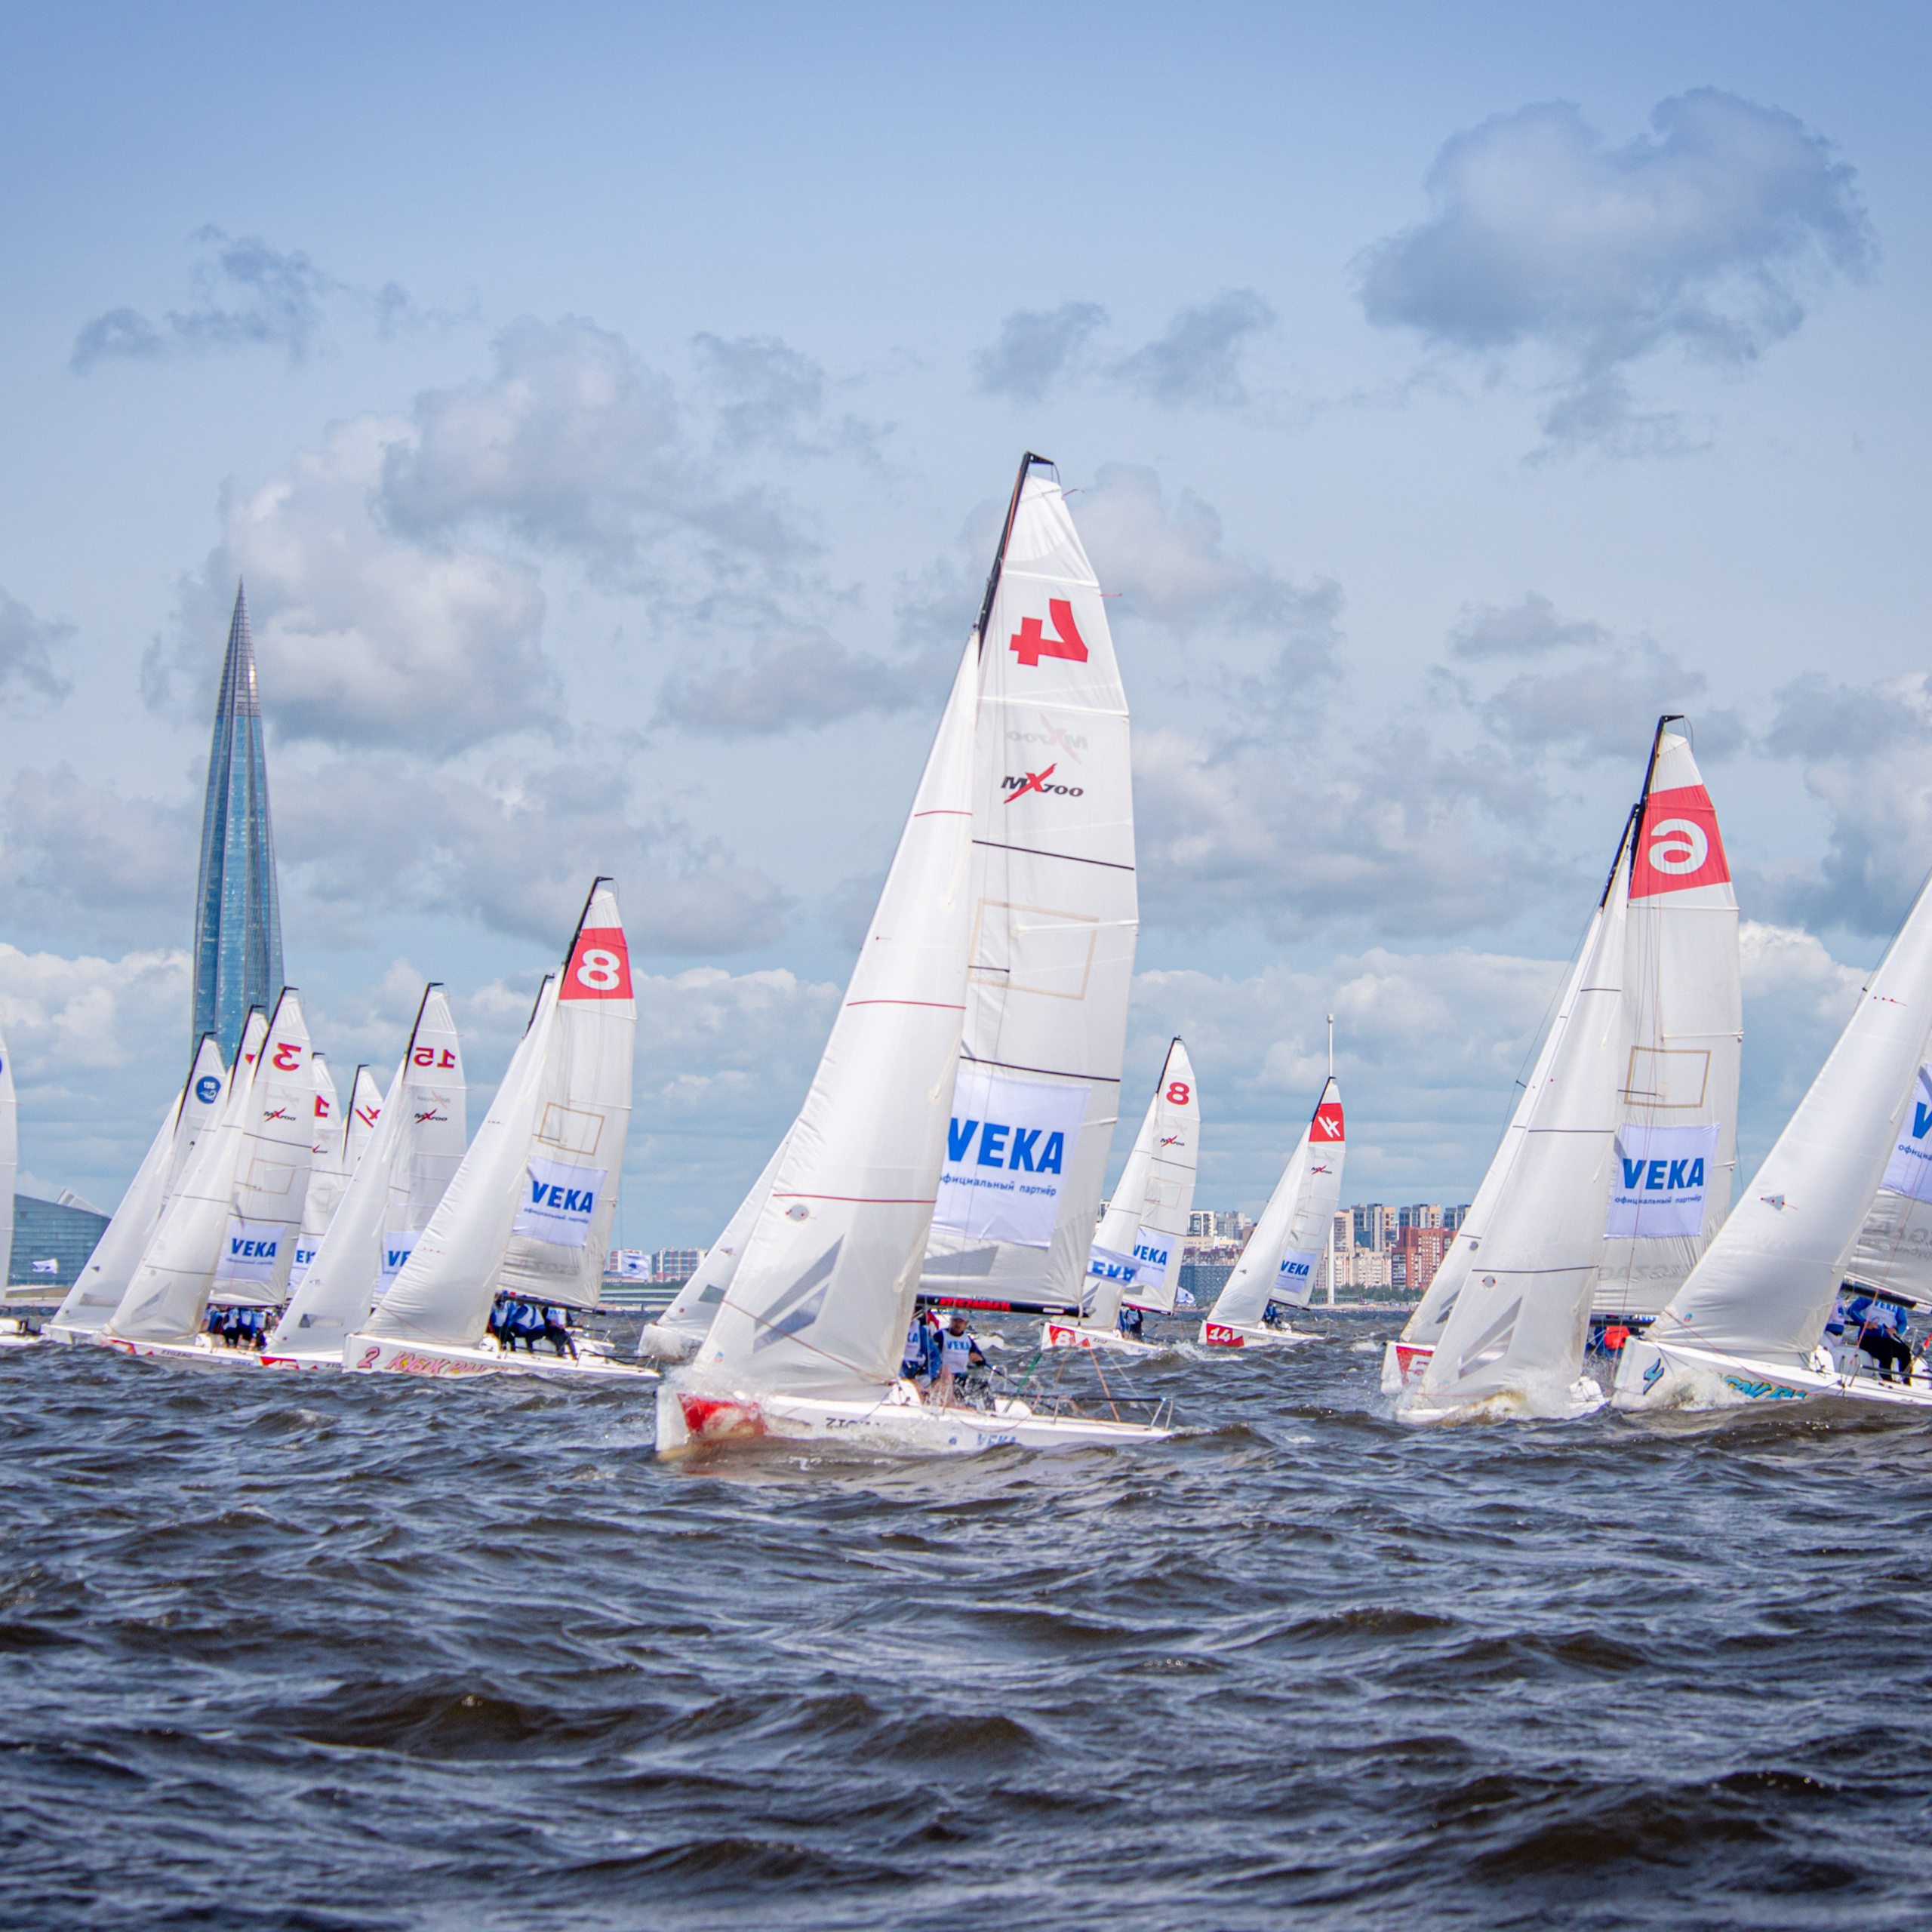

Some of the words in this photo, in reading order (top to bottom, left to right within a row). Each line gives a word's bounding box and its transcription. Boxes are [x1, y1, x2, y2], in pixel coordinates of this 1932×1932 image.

[1001, 763, 1084, 804] MX700
[577, 949, 620, 991] 8
[1166, 1081, 1189, 1105] 8
[948, 1118, 1064, 1174] VEKA
[940, 1173, 1014, 1191] фициальный
[1019, 1184, 1057, 1197] партнёр
[1623, 1158, 1704, 1190] VEKA
[532, 1188, 593, 1214] VEKA
[1615, 1196, 1672, 1205] официальный
[1675, 1194, 1702, 1204] партнёр
[232, 1238, 277, 1257] VEKA
[1134, 1244, 1167, 1266] VEKA
[1280, 1260, 1309, 1276] VEKA
[947, 1340, 970, 1350] VEKA
[1208, 1327, 1232, 1342] 14
[358, 1347, 380, 1368] 2
